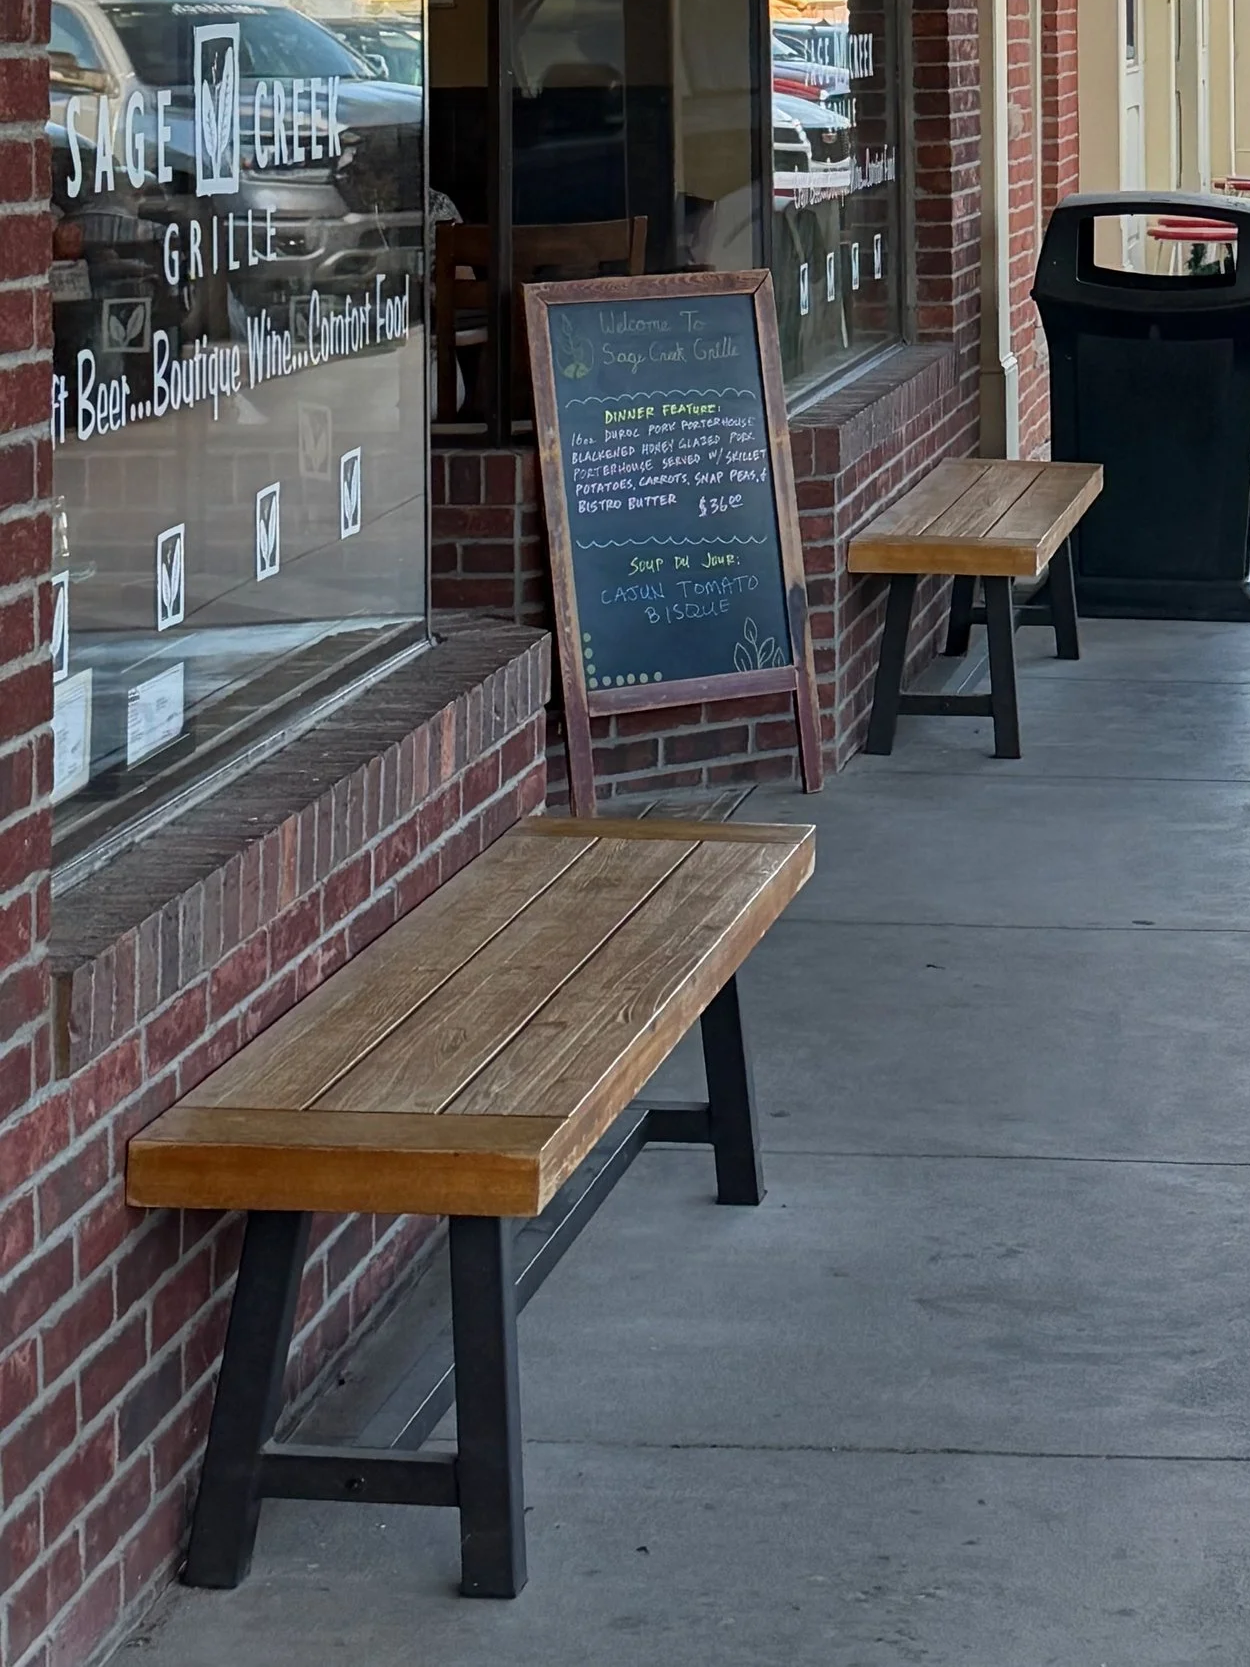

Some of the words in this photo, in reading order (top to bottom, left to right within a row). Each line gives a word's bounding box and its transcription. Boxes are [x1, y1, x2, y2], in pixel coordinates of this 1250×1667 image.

[66, 89, 174, 199] SAGE
[253, 76, 343, 170] CREEK
[163, 205, 278, 286] GRILLE
[376, 274, 410, 343] Food
[599, 310, 671, 335] Welcome
[680, 310, 706, 333] To
[602, 342, 646, 374] Sage
[649, 340, 687, 363] Creek
[693, 336, 740, 361] Grille
[604, 407, 655, 425] DINNER
[648, 422, 676, 435] PORK
[681, 416, 756, 432] PORTERHOUSE
[571, 446, 636, 465] BLACKENED
[641, 439, 675, 455] HONEY
[678, 435, 721, 450] GLAZED
[729, 431, 756, 443] PORK
[573, 459, 654, 482] PORTERHOUSE
[661, 454, 701, 470] SERVED
[725, 448, 767, 464] SKILLET
[694, 470, 724, 486] SNAP
[577, 498, 622, 514] BISTRO
[627, 493, 678, 511] BUTTER
[628, 555, 664, 576] SOUP
[601, 582, 666, 605] CAJUN
[676, 574, 760, 599] TOMATO
[644, 598, 731, 624] BISQUE
